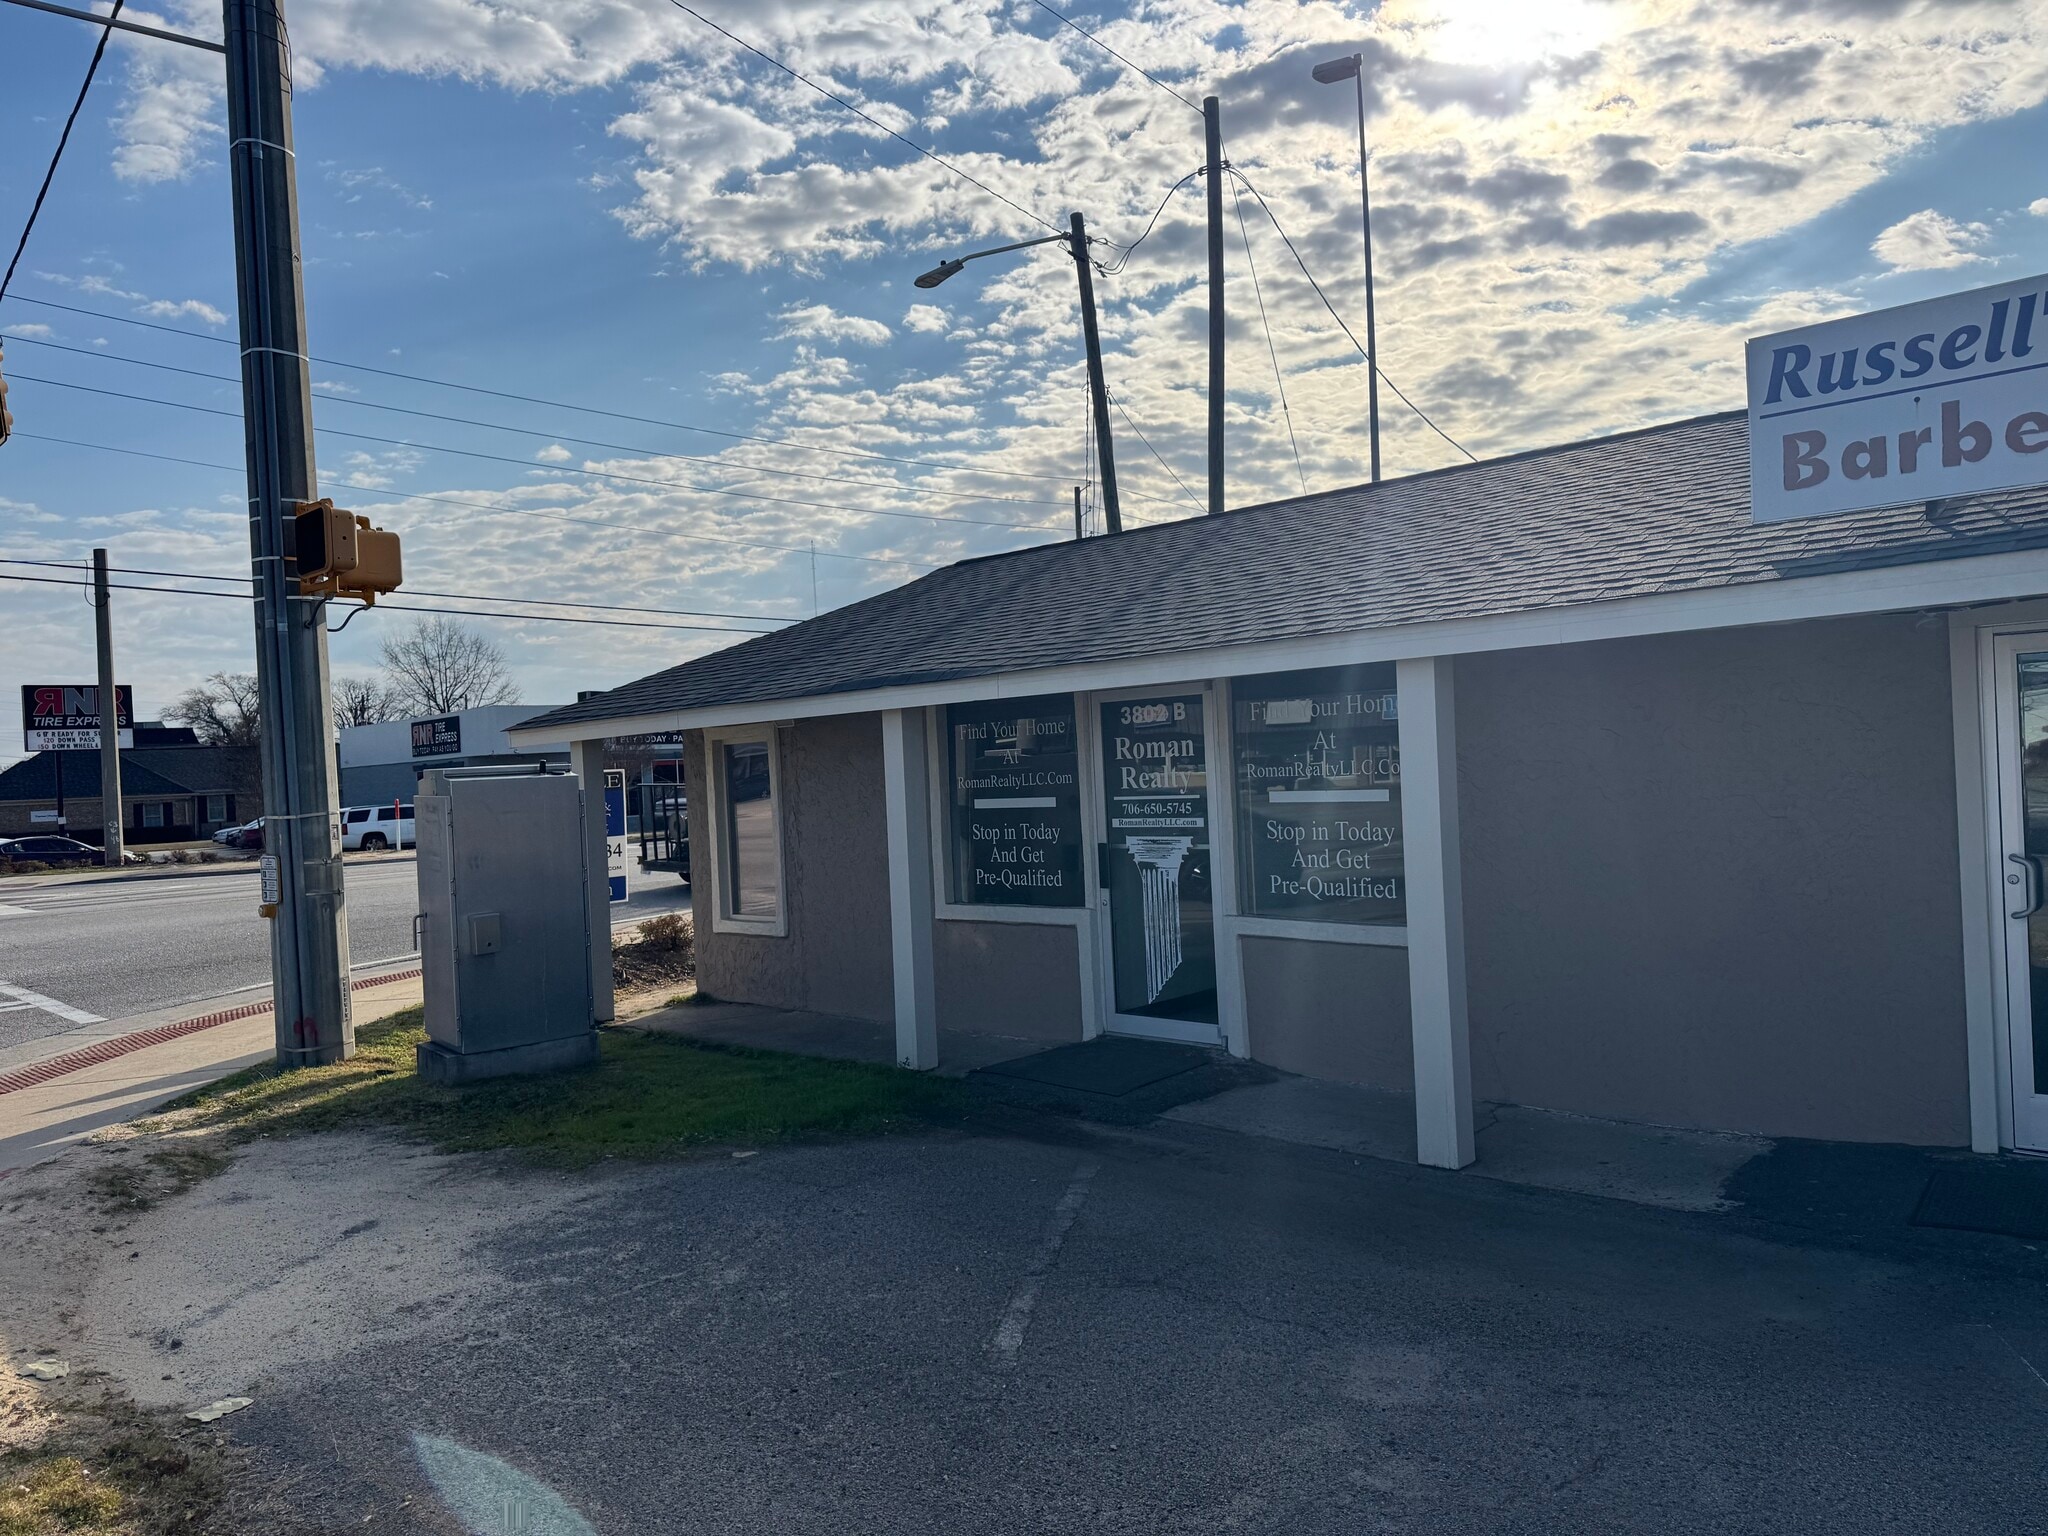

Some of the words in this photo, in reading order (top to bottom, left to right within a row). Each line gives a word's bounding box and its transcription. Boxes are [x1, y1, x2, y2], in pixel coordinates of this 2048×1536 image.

[1173, 702, 1186, 721] B
[1250, 700, 1289, 721] Find
[1346, 694, 1398, 715] Hom
[33, 717, 63, 727] TIRE
[67, 716, 127, 727] EXPRS
[435, 722, 445, 732] TIRE
[960, 723, 987, 741] Find
[990, 721, 1020, 739] Your
[1026, 719, 1065, 736] Home
[413, 724, 434, 746] RNR
[436, 732, 457, 743] EXPRESS
[1313, 730, 1337, 750] At
[1003, 749, 1019, 765] At
[1114, 737, 1194, 760] Roman
[958, 771, 1073, 790] RomanRealtyLLC.Com
[1121, 765, 1192, 794] Realty
[1122, 803, 1192, 816] 706-650-5745
[1118, 818, 1198, 827] RomanRealtyLLC.com
[972, 823, 1001, 844] Stop
[1004, 823, 1016, 840] in
[1019, 823, 1061, 844] Today
[1266, 820, 1305, 846] Stop
[1312, 821, 1328, 841] in
[1335, 821, 1395, 847] Today
[990, 846, 1017, 863] And
[1021, 847, 1045, 863] Get
[1291, 849, 1329, 869] And
[1336, 849, 1371, 869] Get
[976, 869, 1063, 888] Pre-Qualified
[1270, 875, 1398, 900] Pre-Qualified
